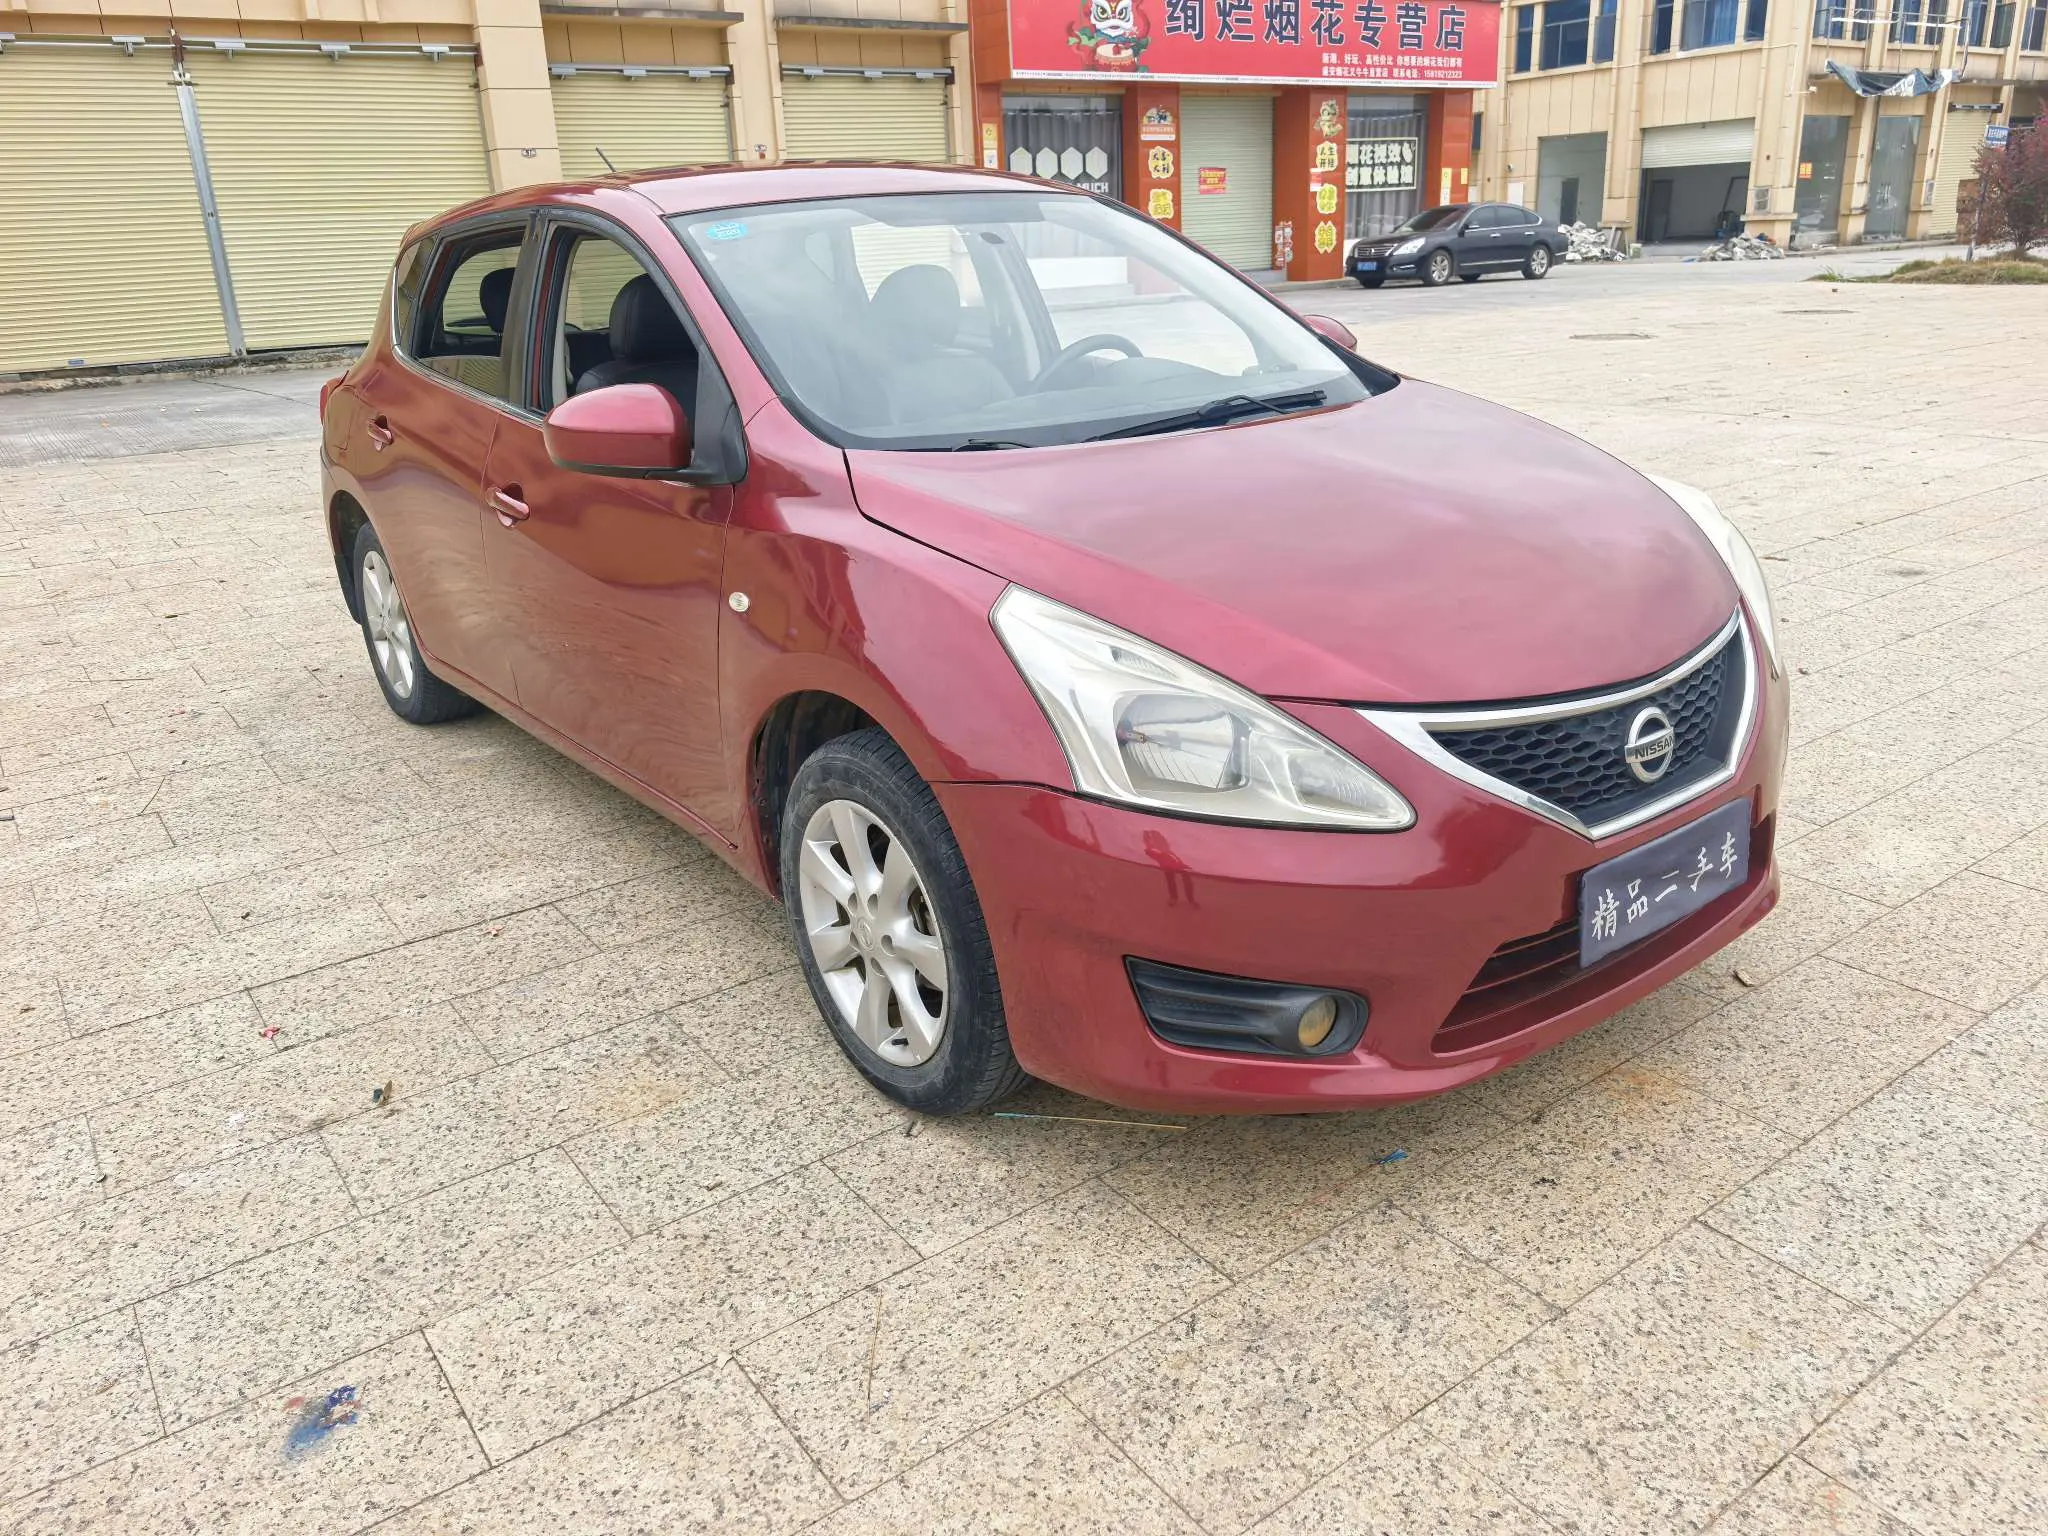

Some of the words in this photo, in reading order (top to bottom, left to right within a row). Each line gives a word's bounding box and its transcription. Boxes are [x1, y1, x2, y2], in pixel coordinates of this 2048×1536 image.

[1164, 0, 1466, 51] 绚烂烟花专营店
[1591, 831, 1738, 941] 精品二手车
